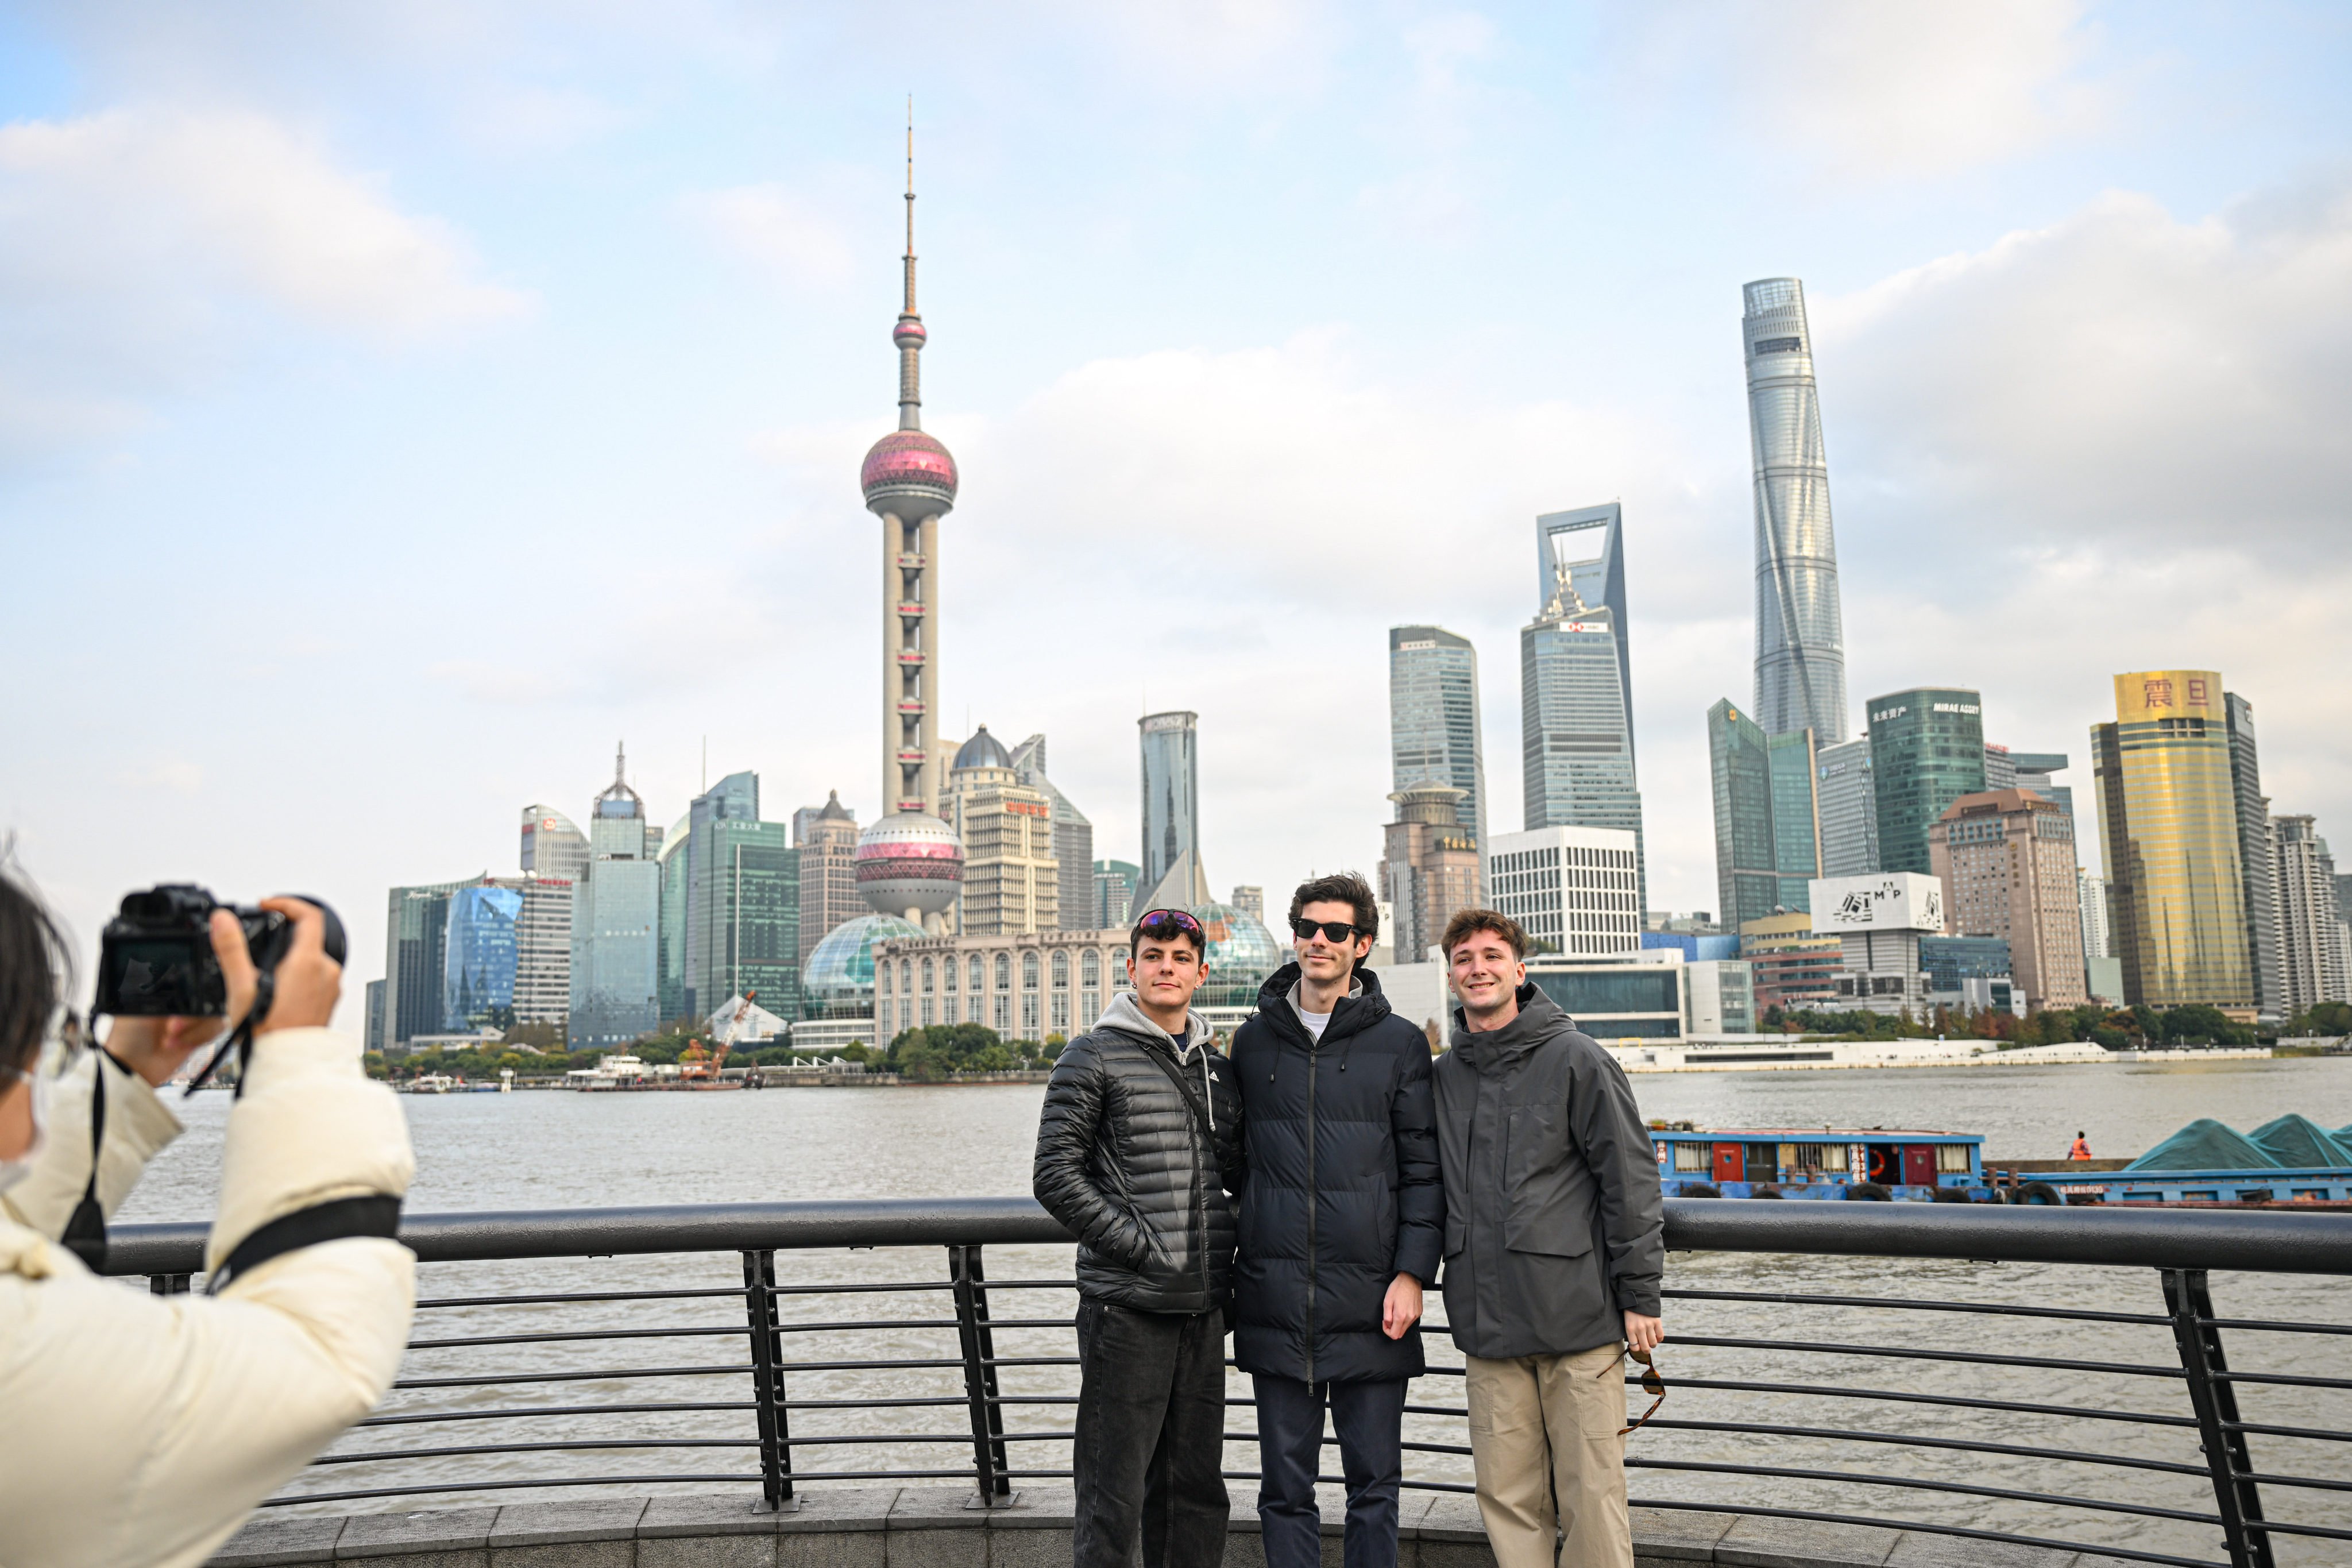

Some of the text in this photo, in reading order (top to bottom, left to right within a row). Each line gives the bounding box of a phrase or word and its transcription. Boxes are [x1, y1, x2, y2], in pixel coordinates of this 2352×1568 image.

[2144, 679, 2209, 708] 震旦
[1933, 702, 1979, 715] MIRAE ASSET
[1874, 882, 1901, 900] MAP
